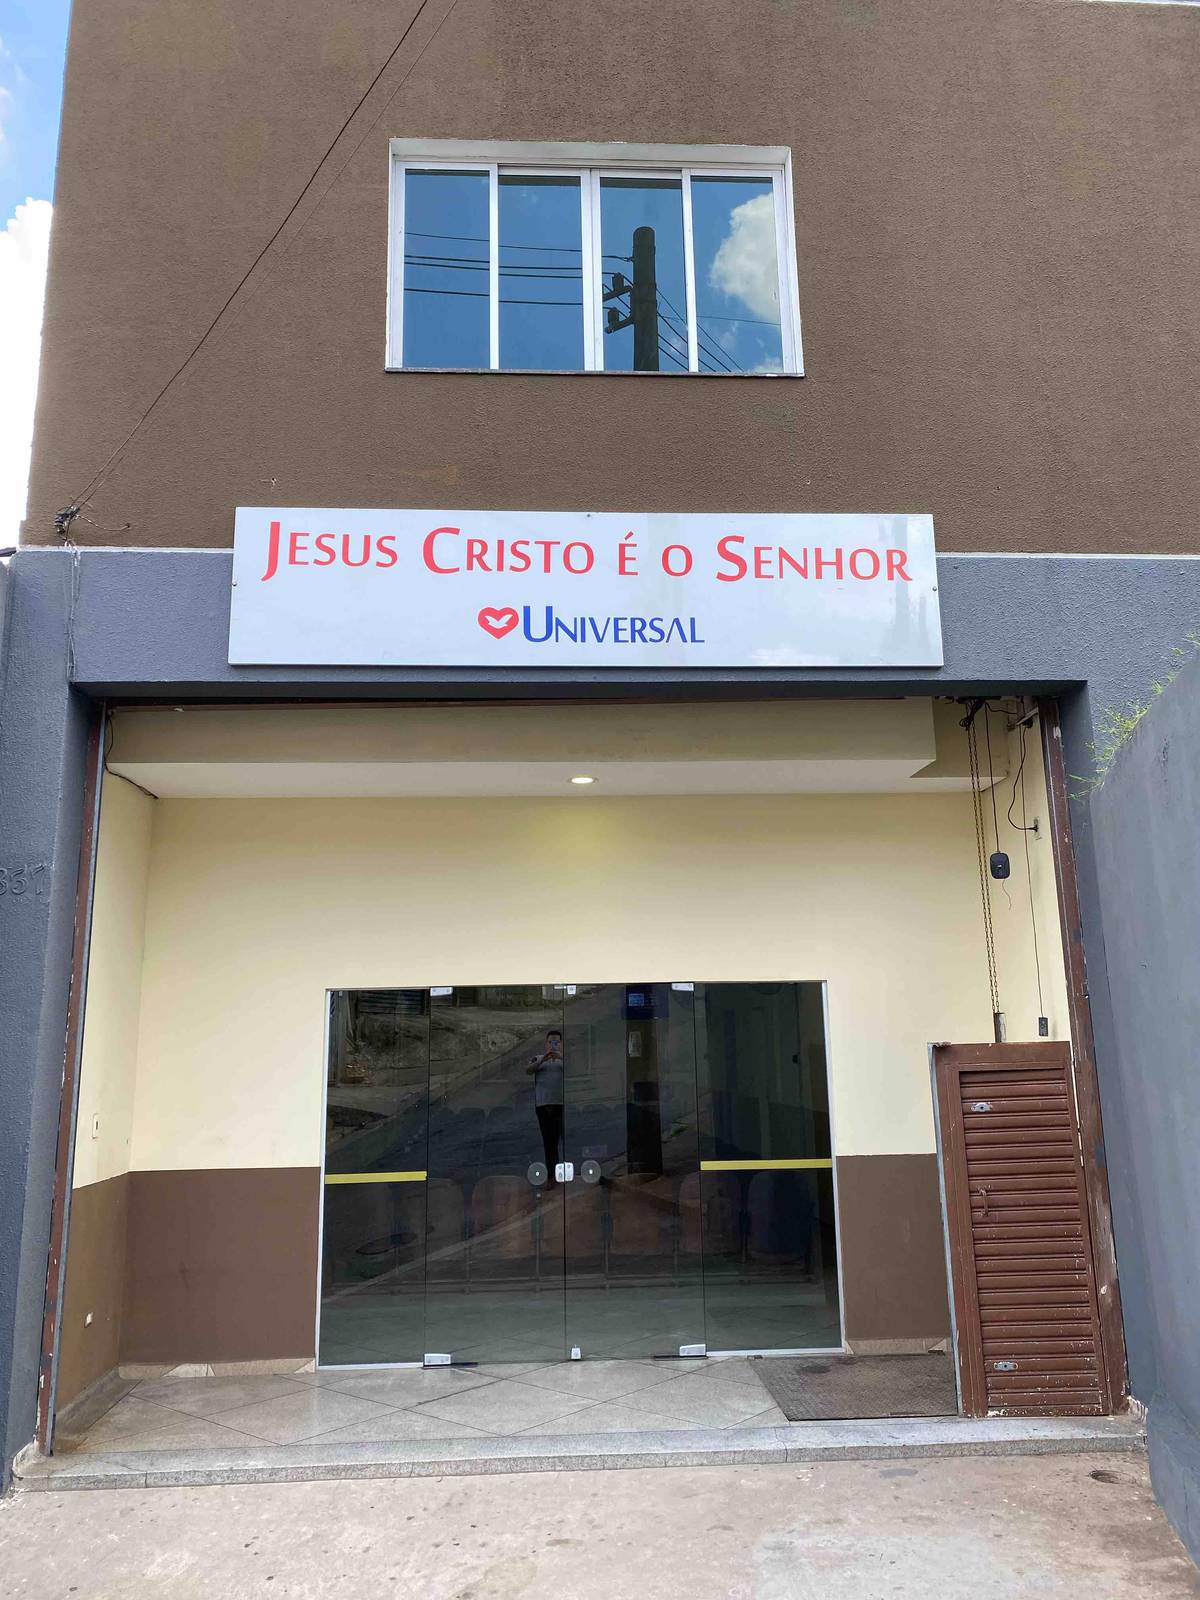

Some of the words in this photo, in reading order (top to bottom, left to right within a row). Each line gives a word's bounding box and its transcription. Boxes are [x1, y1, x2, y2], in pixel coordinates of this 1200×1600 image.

[262, 520, 399, 582] JESUS
[422, 527, 595, 577] CRISTO
[617, 531, 639, 577] É
[661, 544, 693, 577] O
[715, 534, 911, 582] SENHOR
[522, 605, 705, 644] UNIVERSAL
